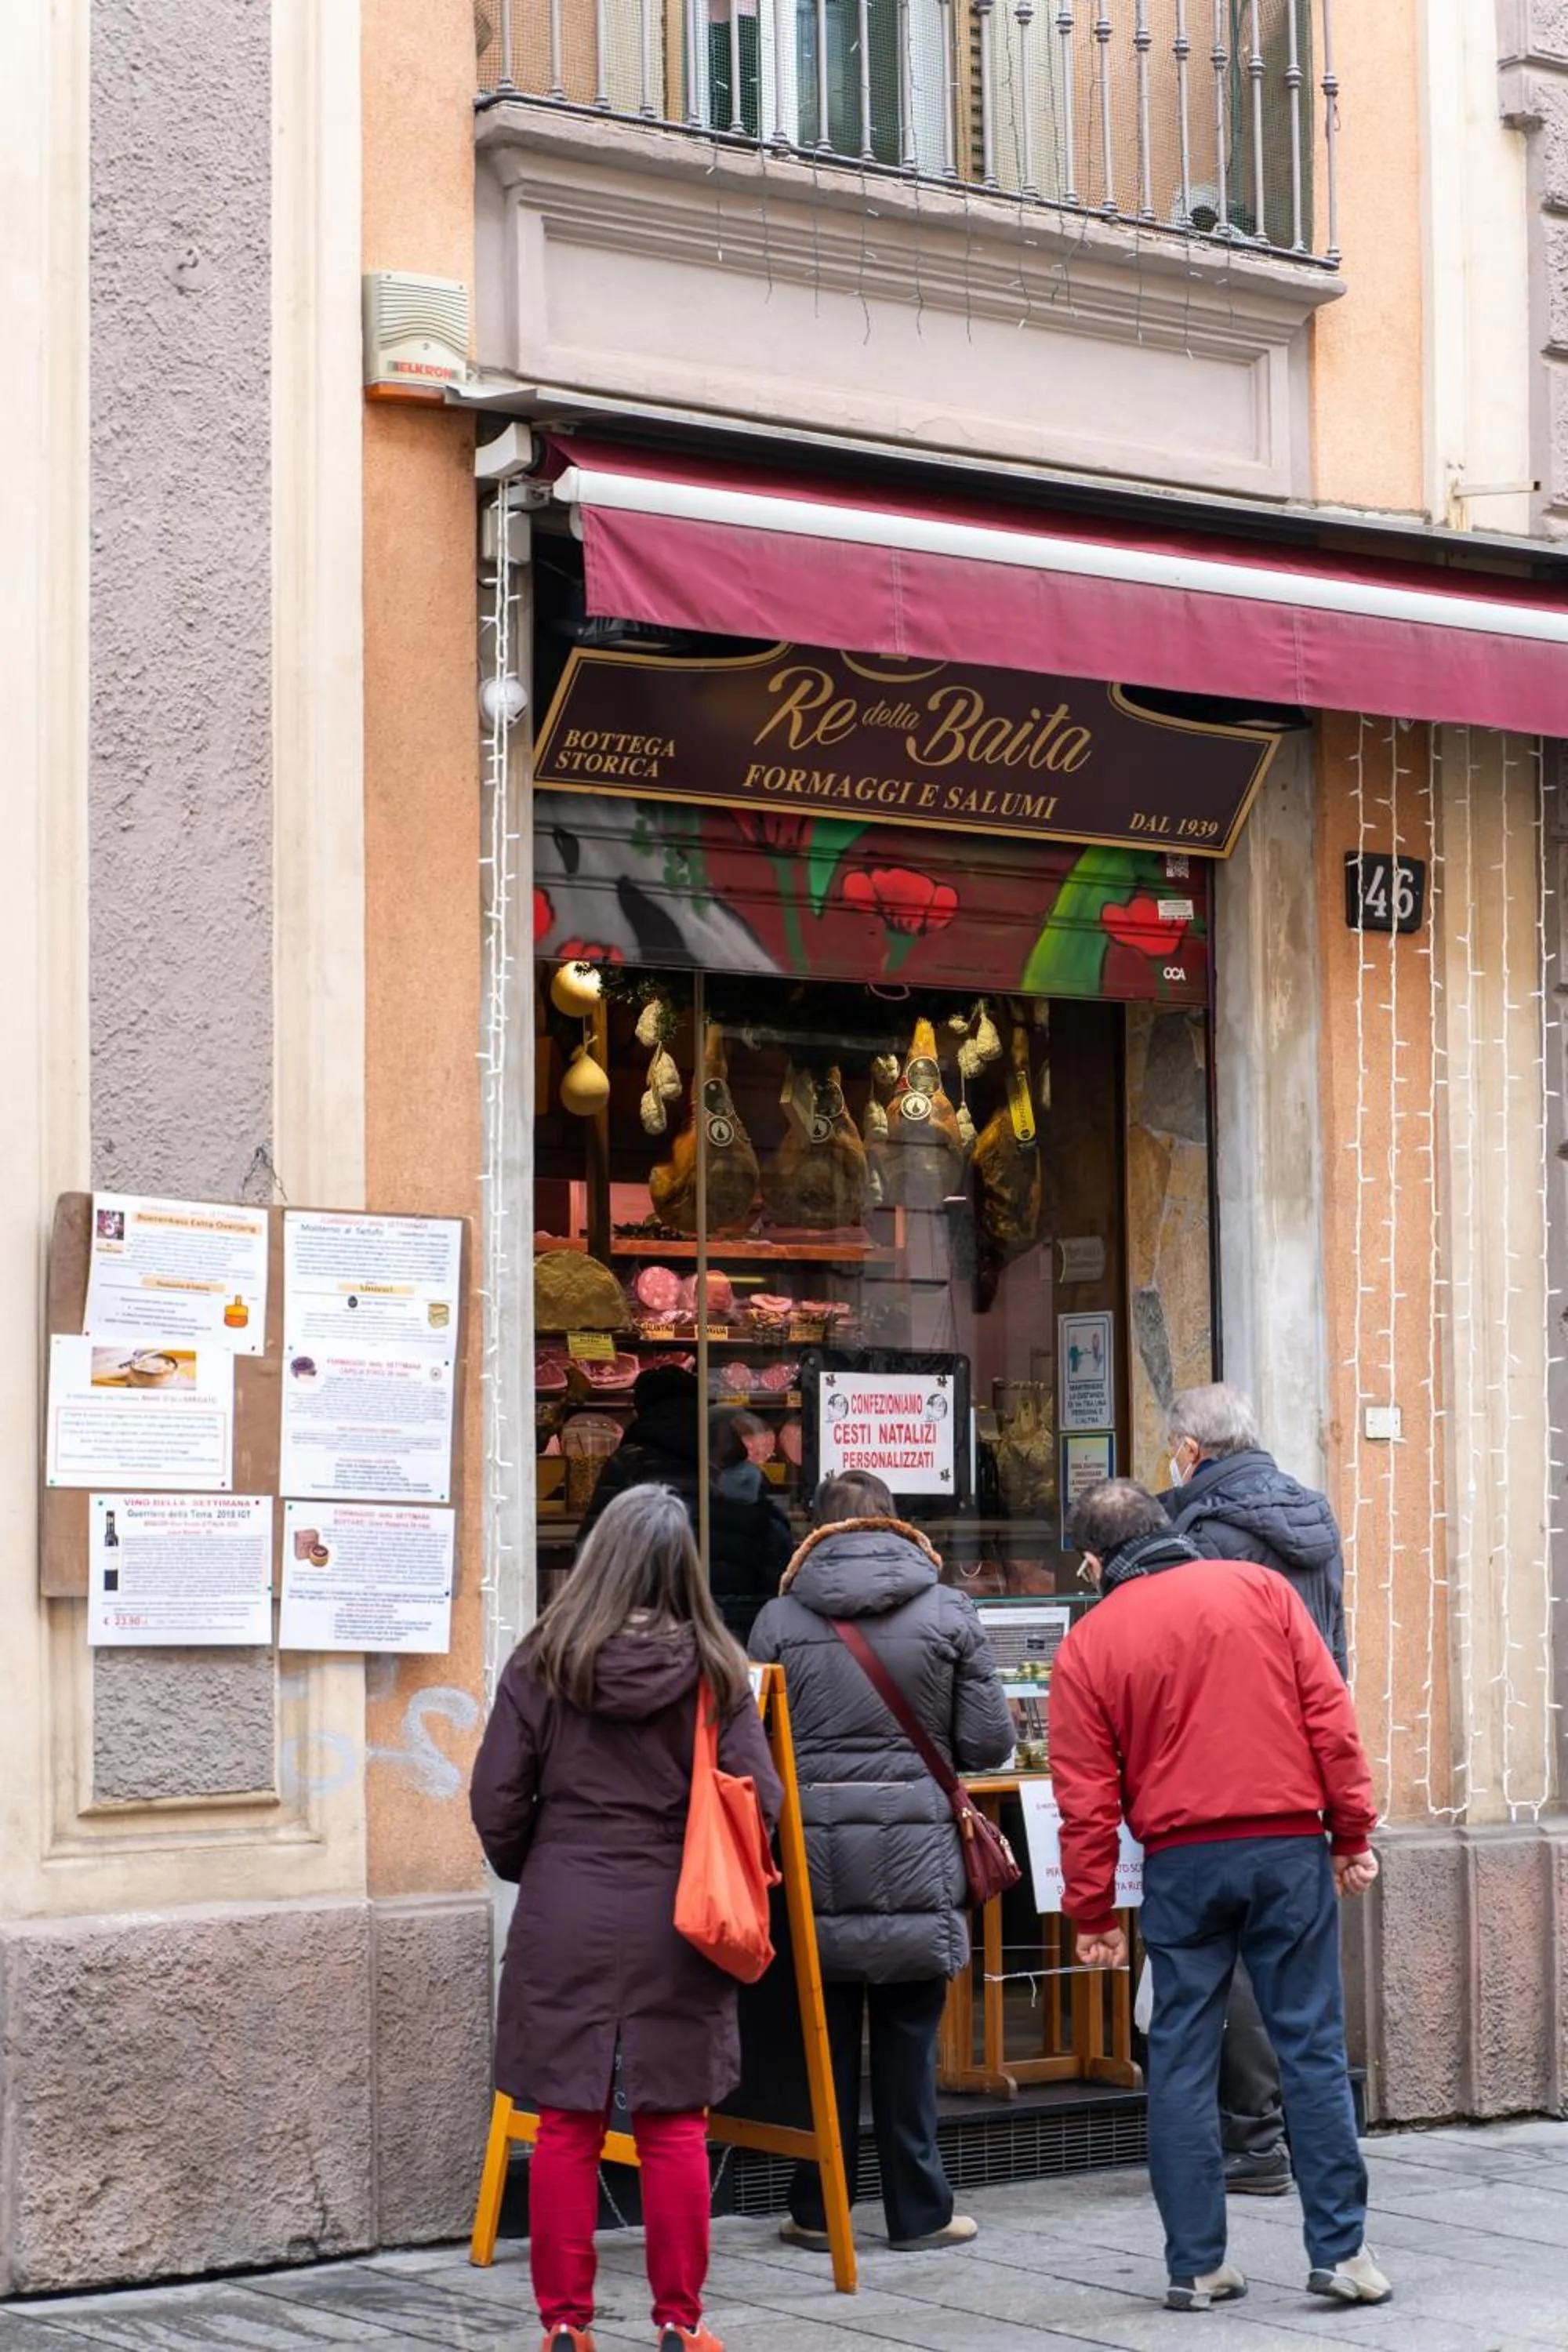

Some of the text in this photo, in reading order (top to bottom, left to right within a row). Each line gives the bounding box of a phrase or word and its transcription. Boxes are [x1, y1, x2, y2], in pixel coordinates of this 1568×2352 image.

[753, 666, 1093, 772] Re della Baita
[564, 728, 677, 757] BOTTEGA
[554, 750, 659, 778] STORICA
[742, 764, 1058, 819] FORMAGGI E SALUMI
[1129, 813, 1219, 838] DAL 1939
[1364, 865, 1414, 919] 46
[851, 1393, 923, 1415] CONFEZIONIAMO
[833, 1423, 937, 1444] CESTI NATALIZI
[843, 1451, 935, 1468] PERSONALIZZATI
